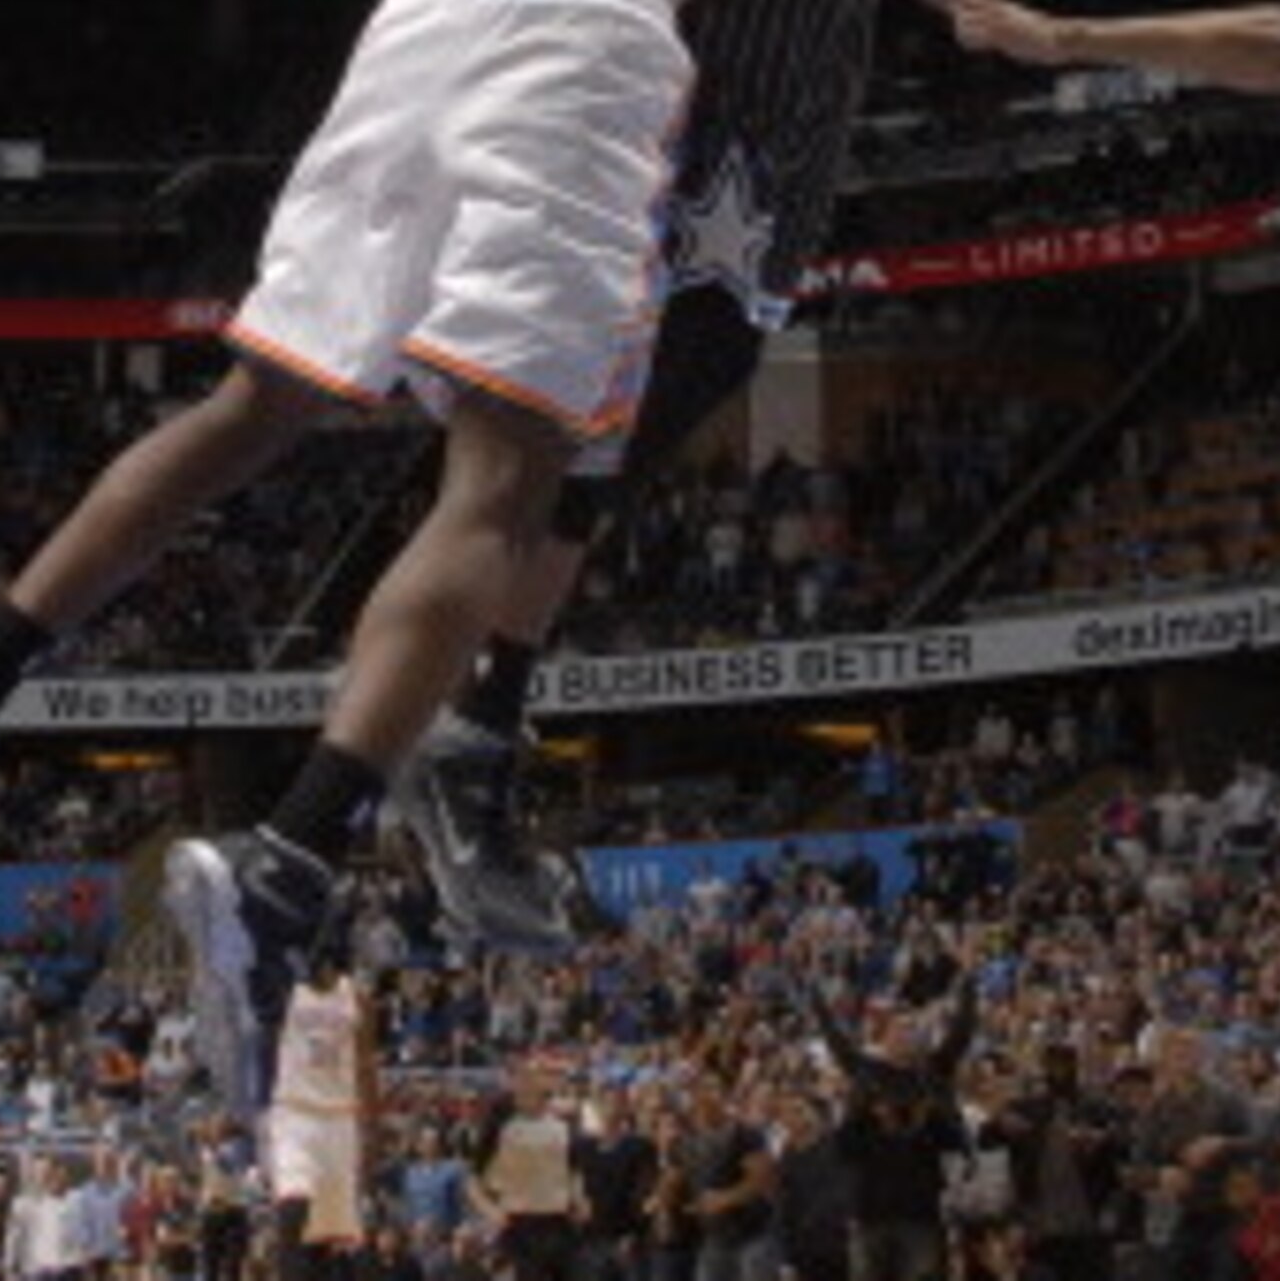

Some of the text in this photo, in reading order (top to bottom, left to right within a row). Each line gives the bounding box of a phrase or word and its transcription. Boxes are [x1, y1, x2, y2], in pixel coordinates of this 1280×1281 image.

[968, 222, 1164, 276] LIMITED
[558, 649, 783, 705] BUSINESS
[793, 633, 974, 687] BETTER
[42, 687, 112, 719] We
[122, 685, 212, 728] help
